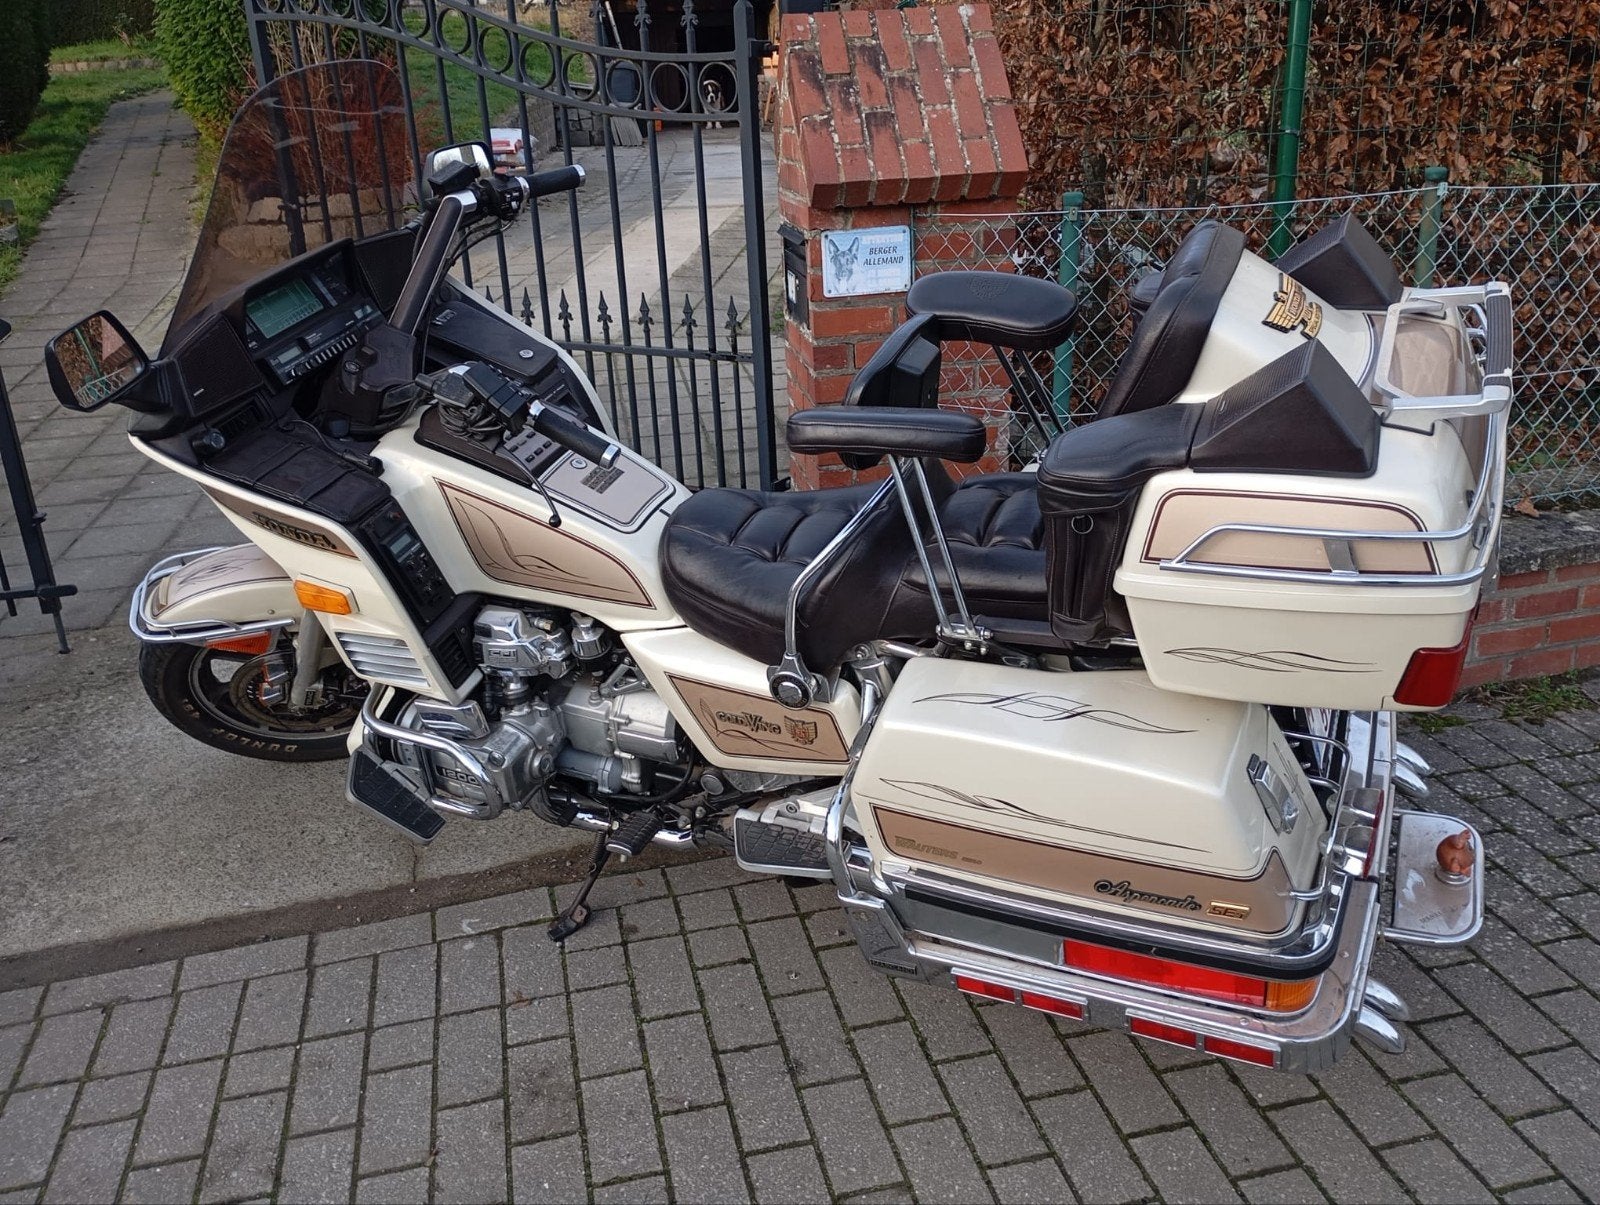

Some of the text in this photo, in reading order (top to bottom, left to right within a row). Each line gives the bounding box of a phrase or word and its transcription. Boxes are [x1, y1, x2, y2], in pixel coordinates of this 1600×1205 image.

[869, 245, 898, 256] BERGER
[863, 255, 904, 266] ALLEMAND
[211, 728, 298, 753] DUNLOP
[442, 768, 479, 785] 1200
[1094, 879, 1202, 912] Aspencade
